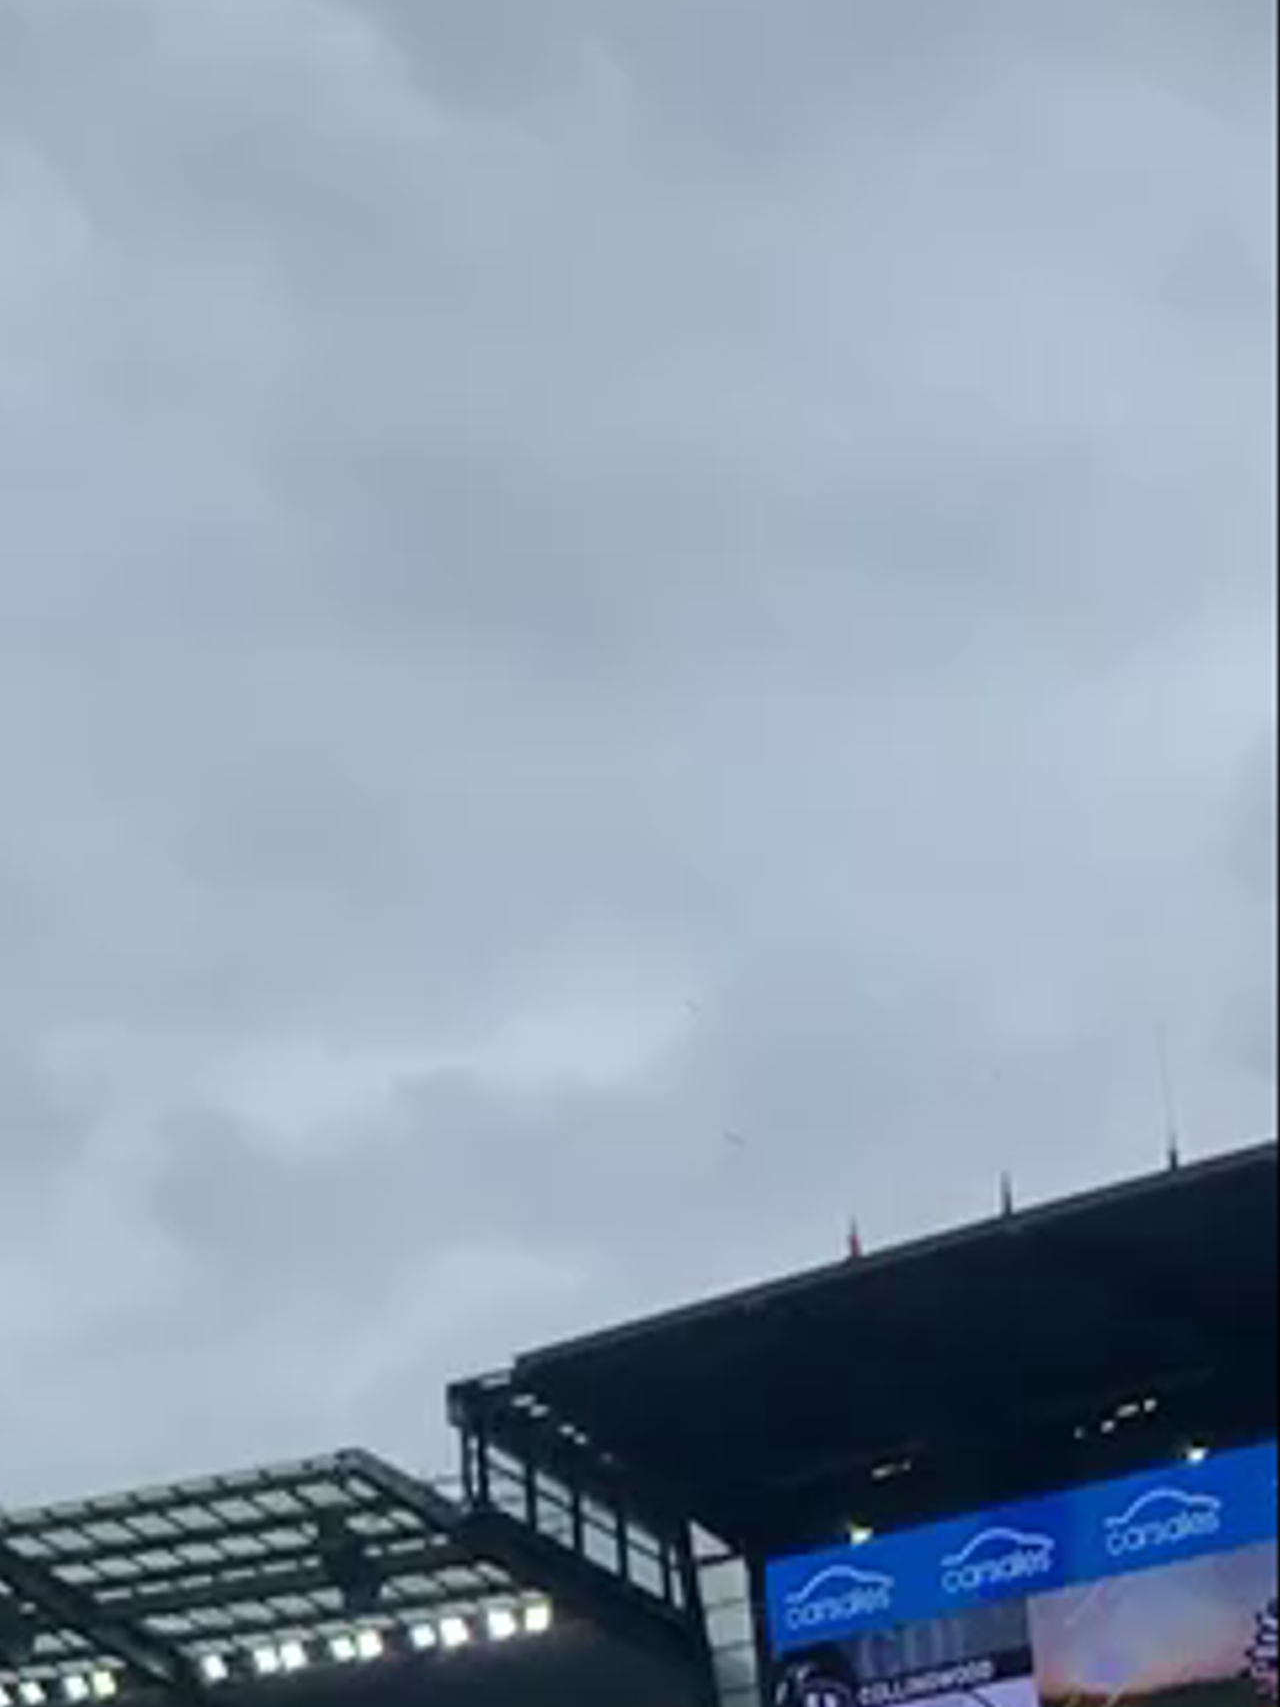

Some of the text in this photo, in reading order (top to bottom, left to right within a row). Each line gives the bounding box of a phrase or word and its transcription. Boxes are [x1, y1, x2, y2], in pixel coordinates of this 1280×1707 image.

[1107, 1510, 1220, 1557] carsales
[941, 1549, 1052, 1593] carsales
[786, 1586, 890, 1629] carsales
